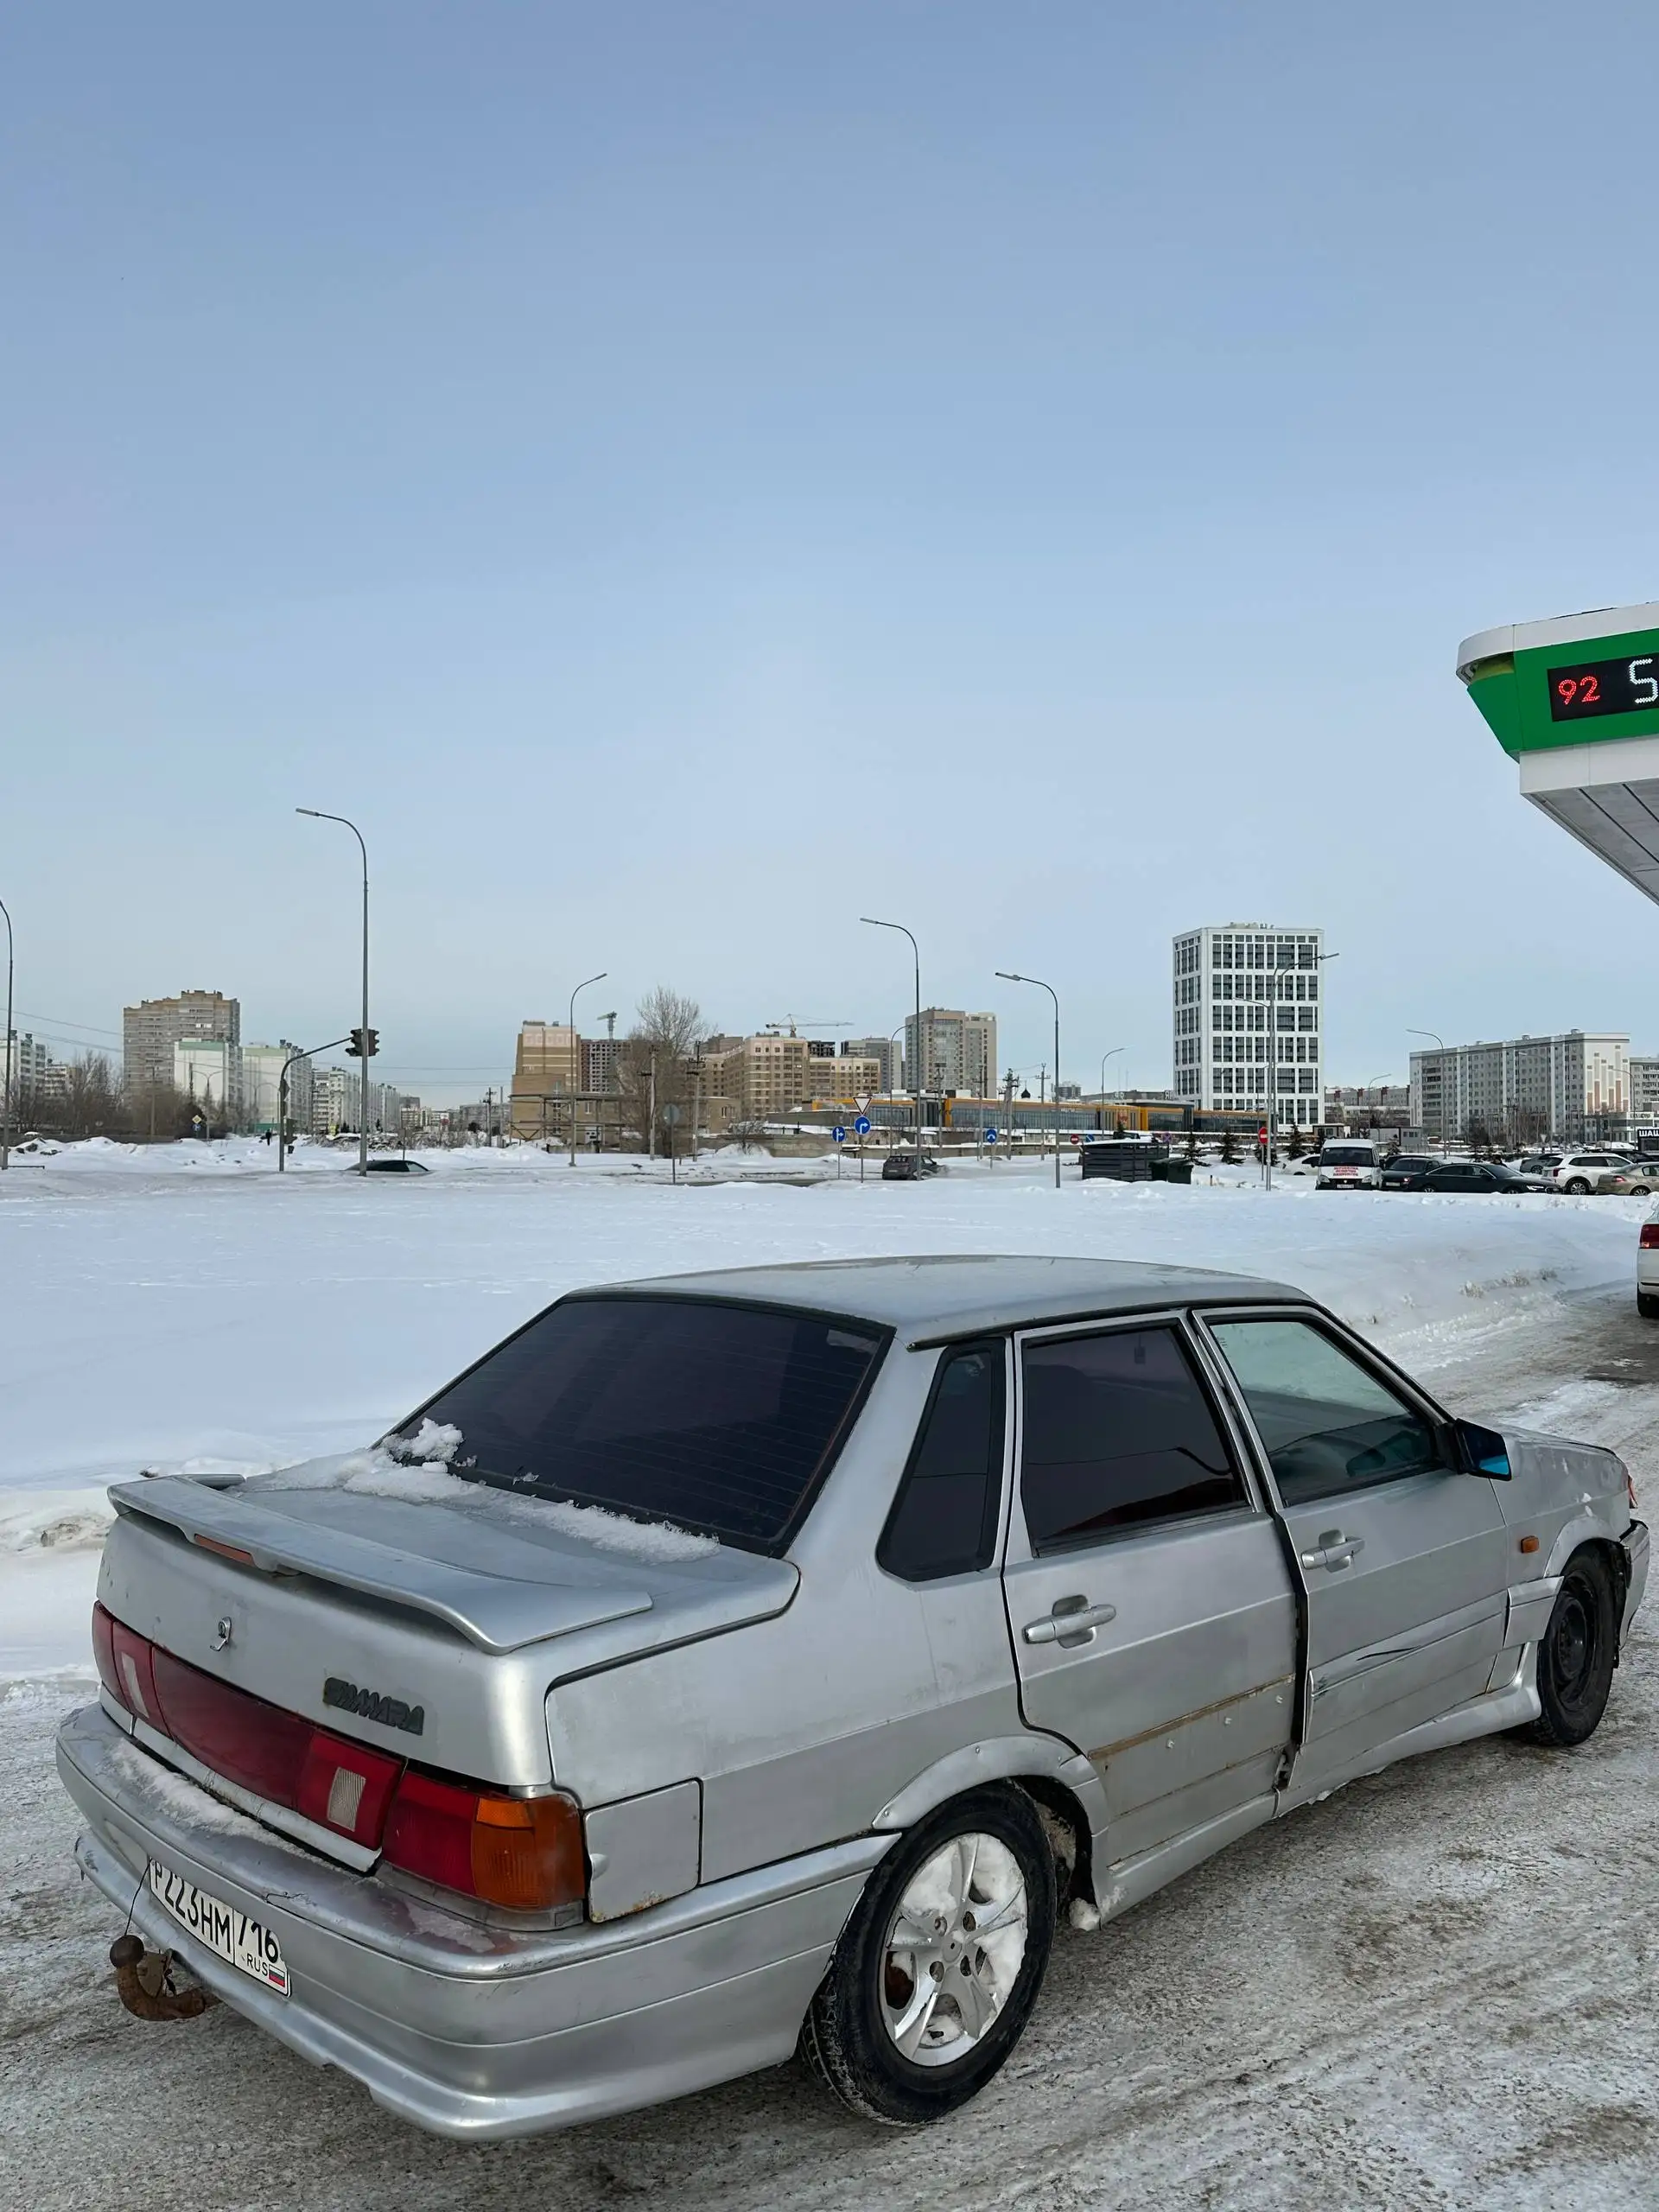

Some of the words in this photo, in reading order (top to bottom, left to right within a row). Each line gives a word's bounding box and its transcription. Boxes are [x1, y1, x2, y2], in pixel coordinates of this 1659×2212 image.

[1558, 676, 1600, 705] 92
[1629, 658, 1659, 703] 5
[246, 1954, 268, 1976] RUS
